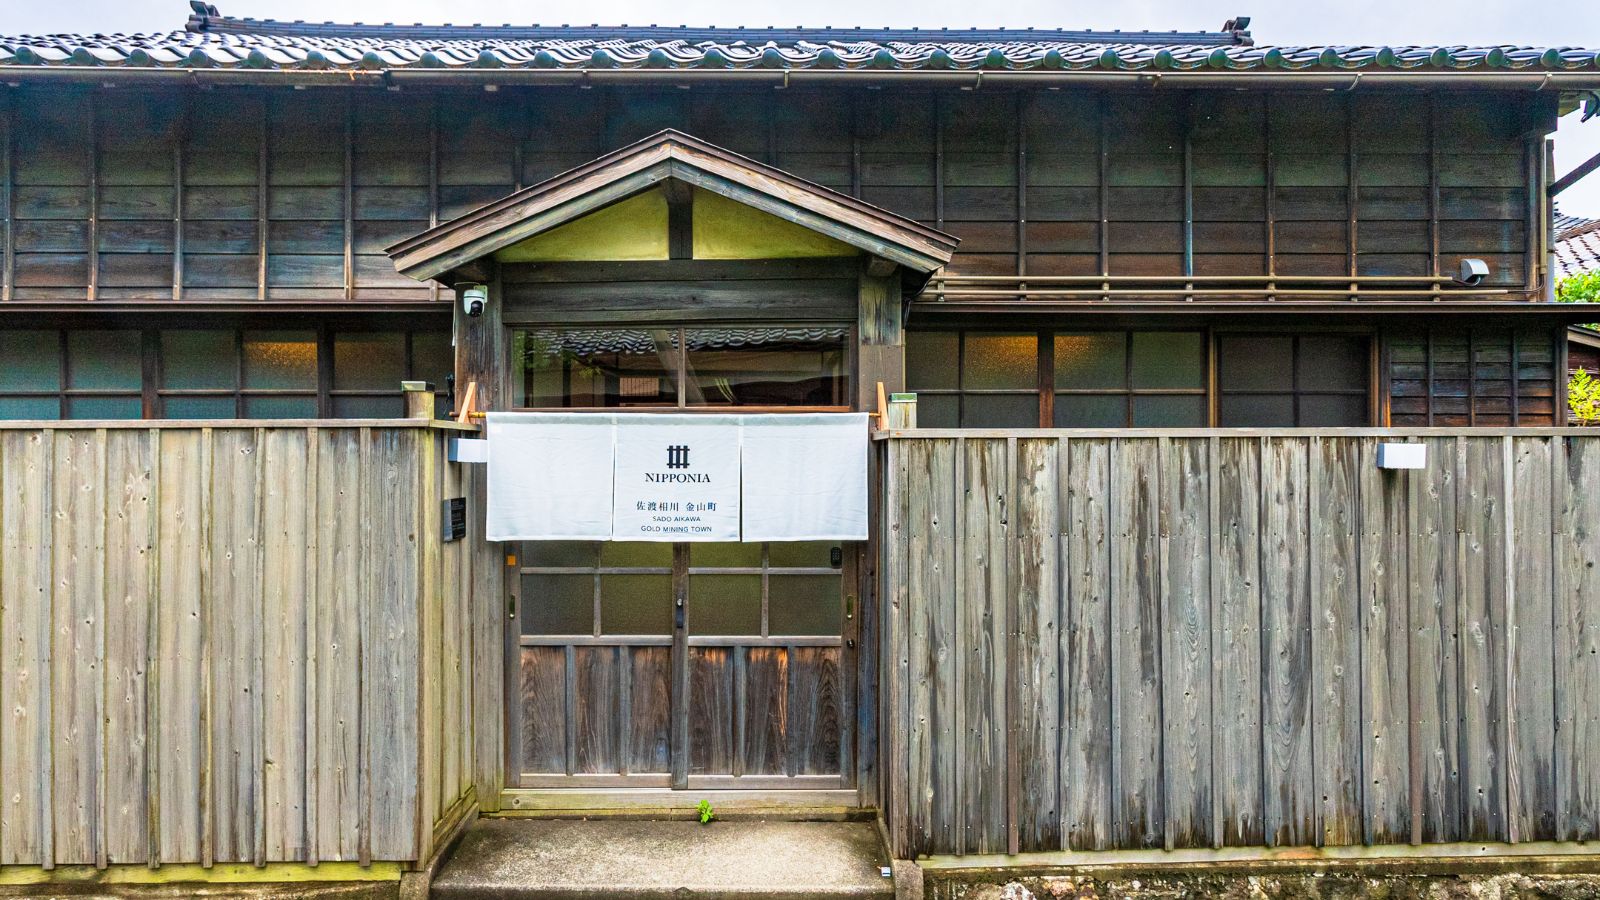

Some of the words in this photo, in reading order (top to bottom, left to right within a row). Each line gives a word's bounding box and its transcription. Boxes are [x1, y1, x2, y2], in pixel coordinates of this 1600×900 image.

[645, 473, 711, 483] NIPPONIA
[636, 501, 679, 511] 佐渡相川
[686, 502, 717, 511] 金山町
